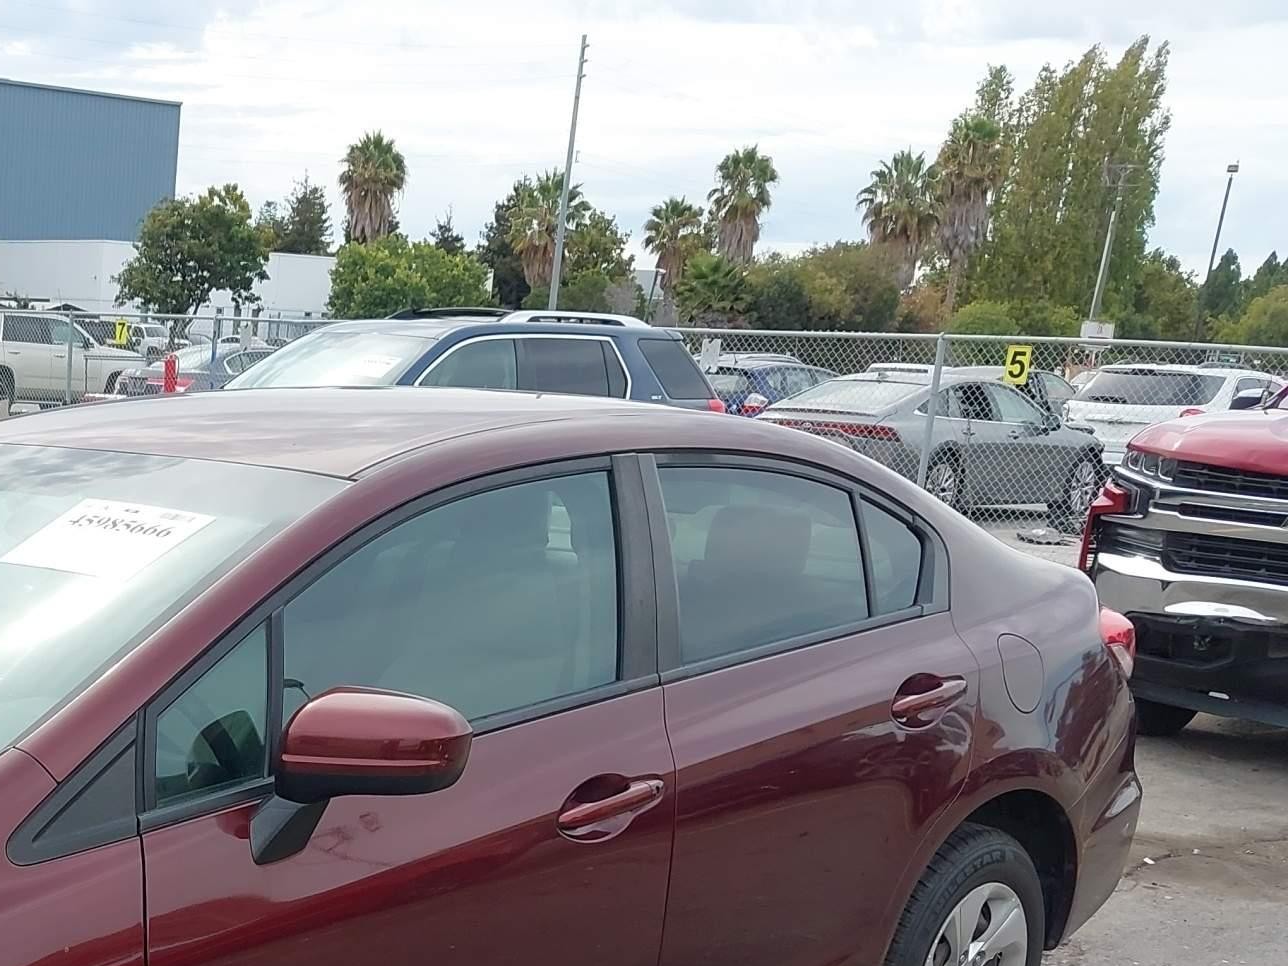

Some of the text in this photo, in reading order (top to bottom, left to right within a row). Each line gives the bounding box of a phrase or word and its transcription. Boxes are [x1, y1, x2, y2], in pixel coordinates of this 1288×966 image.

[117, 322, 126, 341] 7
[1008, 351, 1026, 378] 5
[68, 513, 177, 539] 45985666
